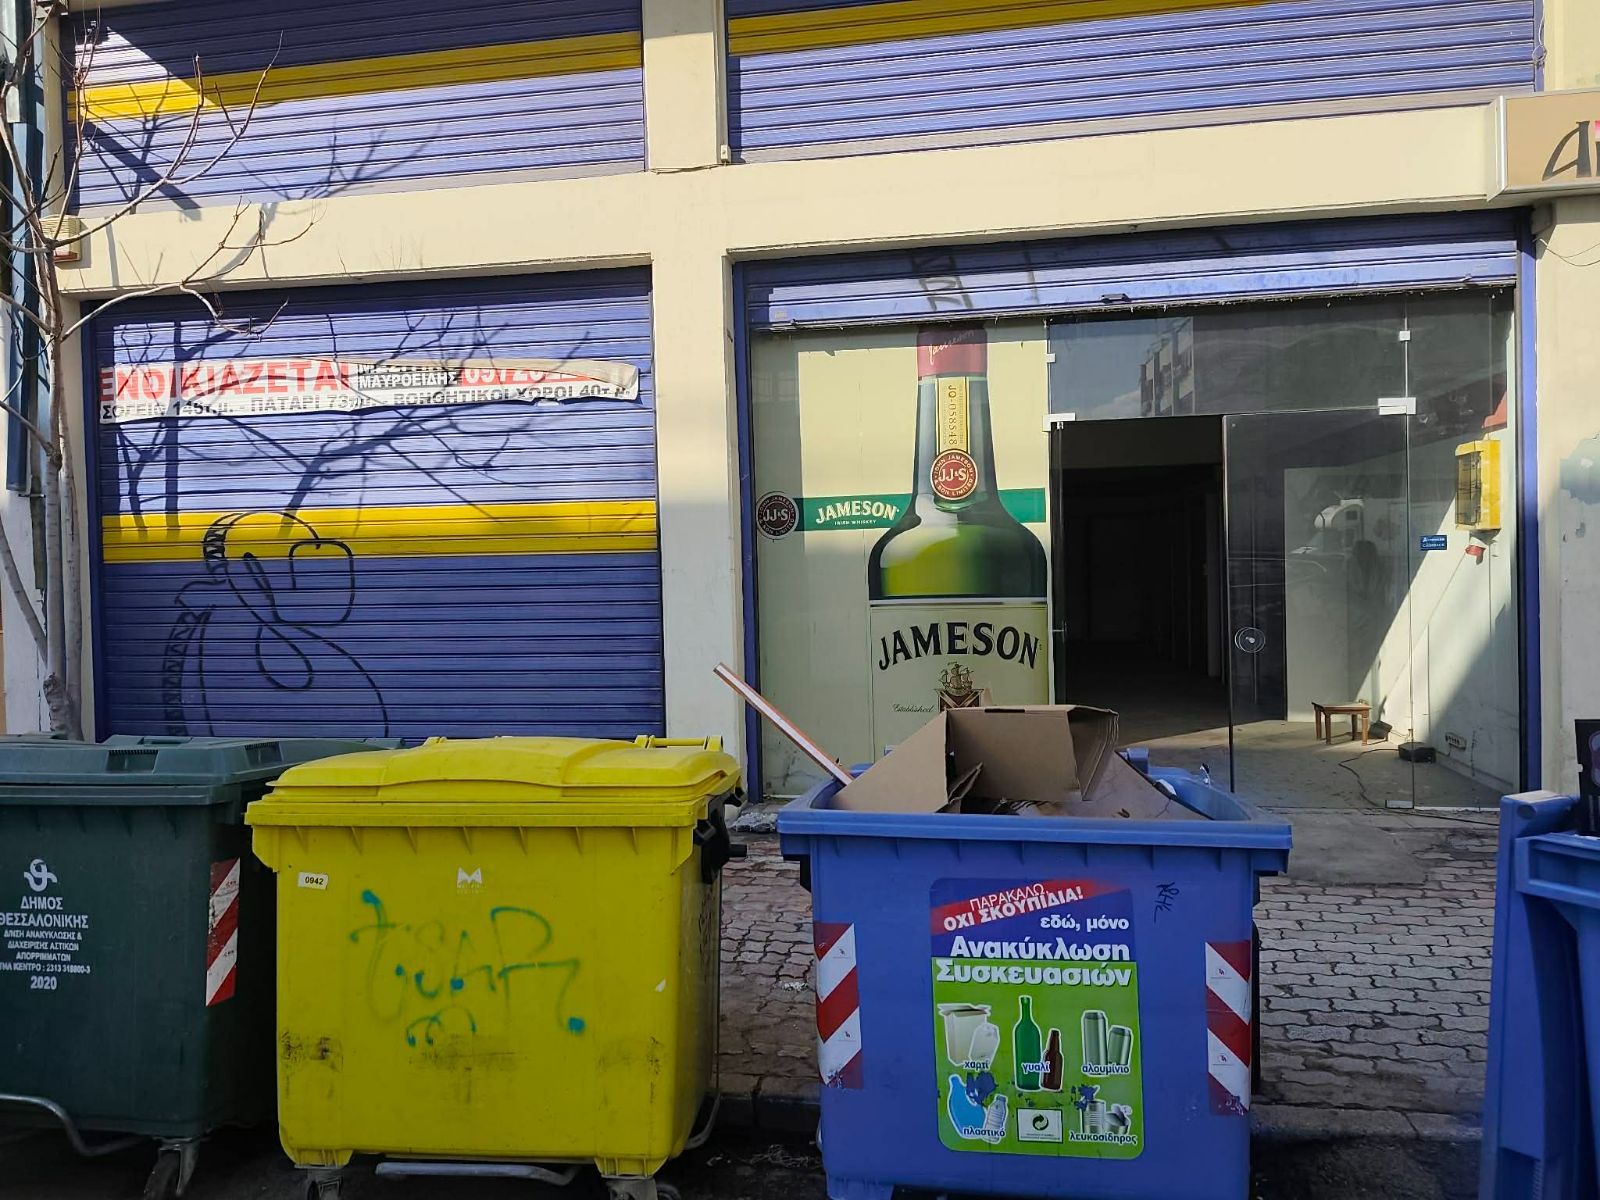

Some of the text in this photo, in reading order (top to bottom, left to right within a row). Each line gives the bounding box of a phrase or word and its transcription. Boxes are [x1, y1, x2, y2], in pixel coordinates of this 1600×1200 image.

[100, 360, 350, 402] ΕΝΟΙΚΙΑΖΕΤΑΙ
[359, 371, 457, 388] ΜΑΥΡΟΕΙΔΗΣ
[815, 500, 897, 524] JAMESON
[878, 622, 1039, 671] JAMESON
[304, 876, 324, 886] 0942
[20, 896, 63, 910] ΔΗΜΟΣ
[943, 886, 1084, 932] ΟΧΙ ΣΚΟΥΠΙΔΙΑ!
[0, 912, 89, 929] ΘΕΣΣΑΛΟΝΙΚΗΣ
[1039, 913, 1130, 932] εδώ, μόνο
[25, 930, 76, 941] ΑΝΑΚΥΚΛΩΣΗΣ
[7, 941, 79, 951] ΔΙΑΧΕΙΡΙΣΗΣ ΑΣΤΙΚΩΝ
[950, 935, 1130, 961] Ανακύκλωση
[16, 952, 71, 962] ΑΠΟΡΡΙΜΜΑΤΩΝ
[46, 964, 62, 973] 2313
[935, 959, 1132, 987] Συσκευασιών
[30, 975, 57, 990] 2020
[964, 1060, 990, 1071] χαρτί
[1022, 1061, 1052, 1074] γυαλί
[1082, 1062, 1130, 1076] αλουμίνιο
[963, 1126, 1006, 1138] πλαστικό
[1069, 1131, 1137, 1145] λευκοσίδηρος
